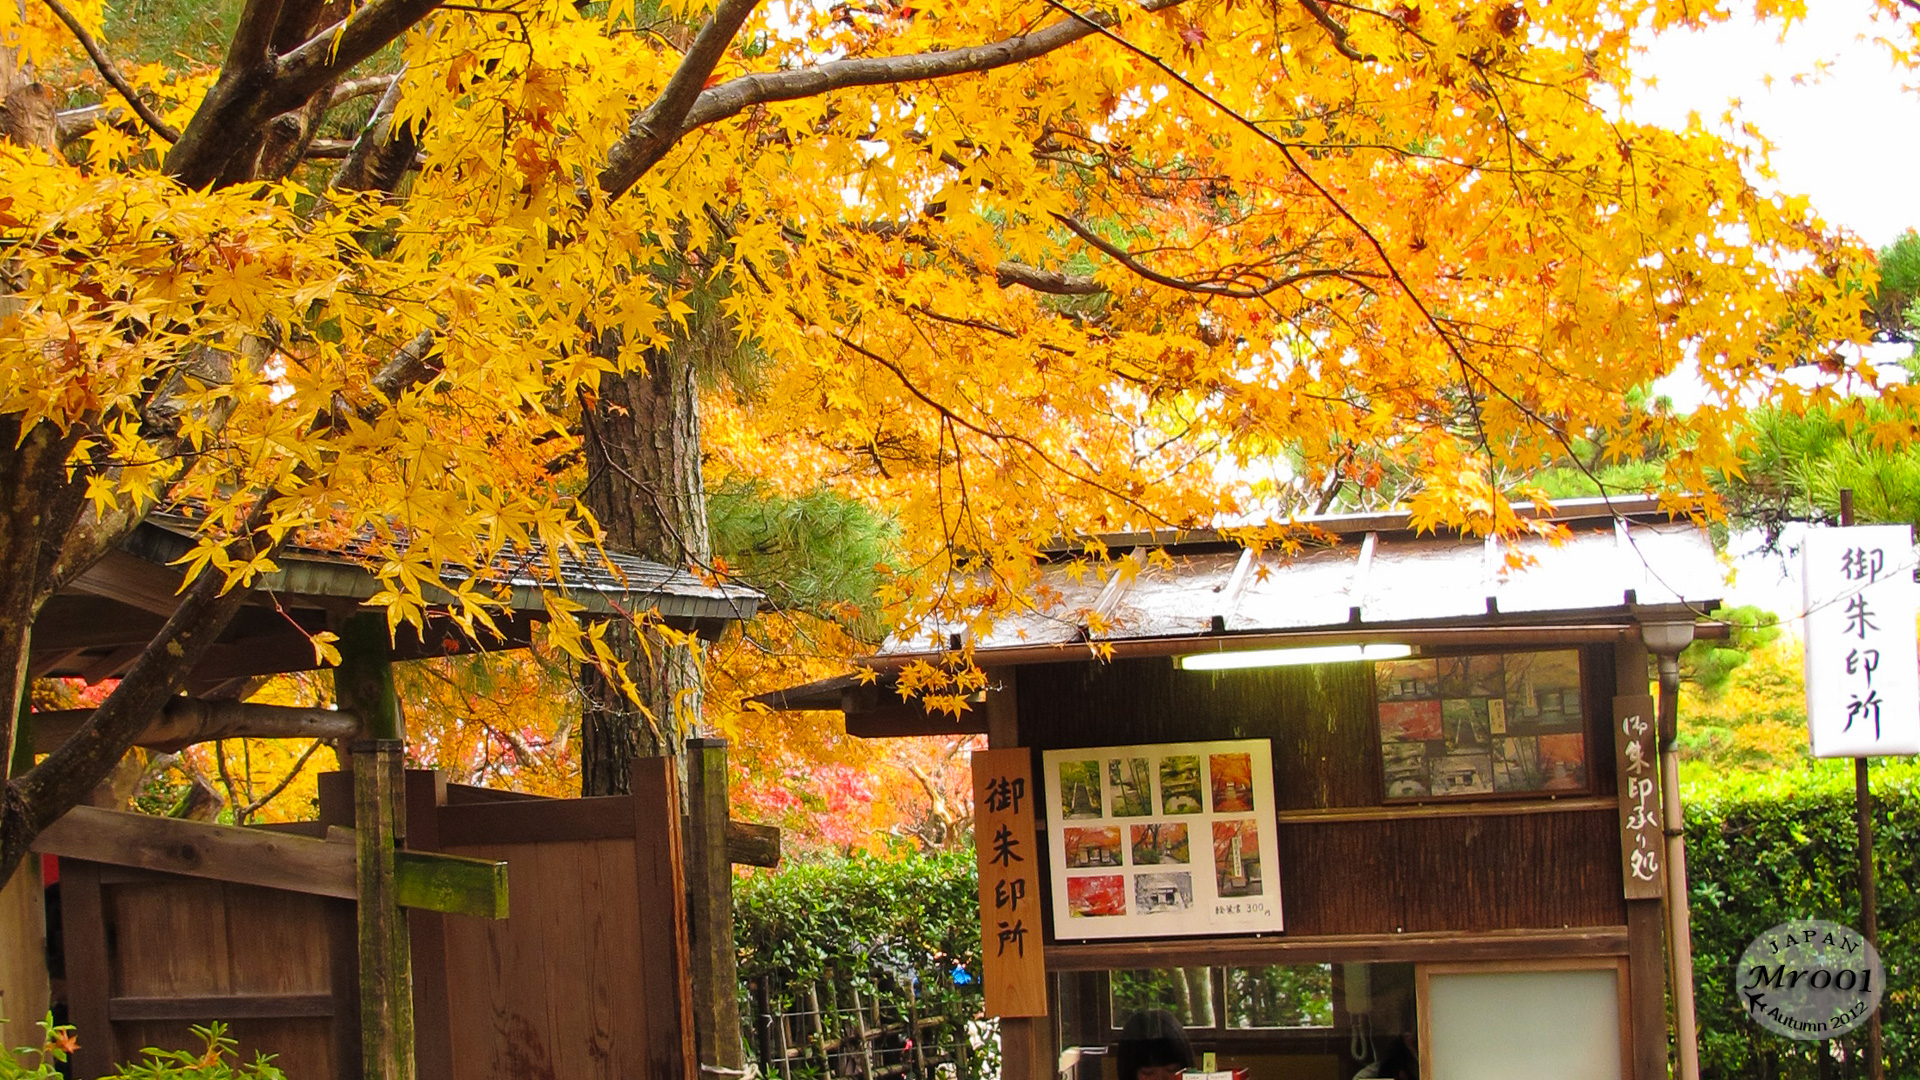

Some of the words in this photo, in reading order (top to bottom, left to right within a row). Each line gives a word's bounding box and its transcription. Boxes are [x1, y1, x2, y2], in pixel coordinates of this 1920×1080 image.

[1840, 546, 1884, 742] 御朱印所
[984, 776, 1028, 959] 御朱印所
